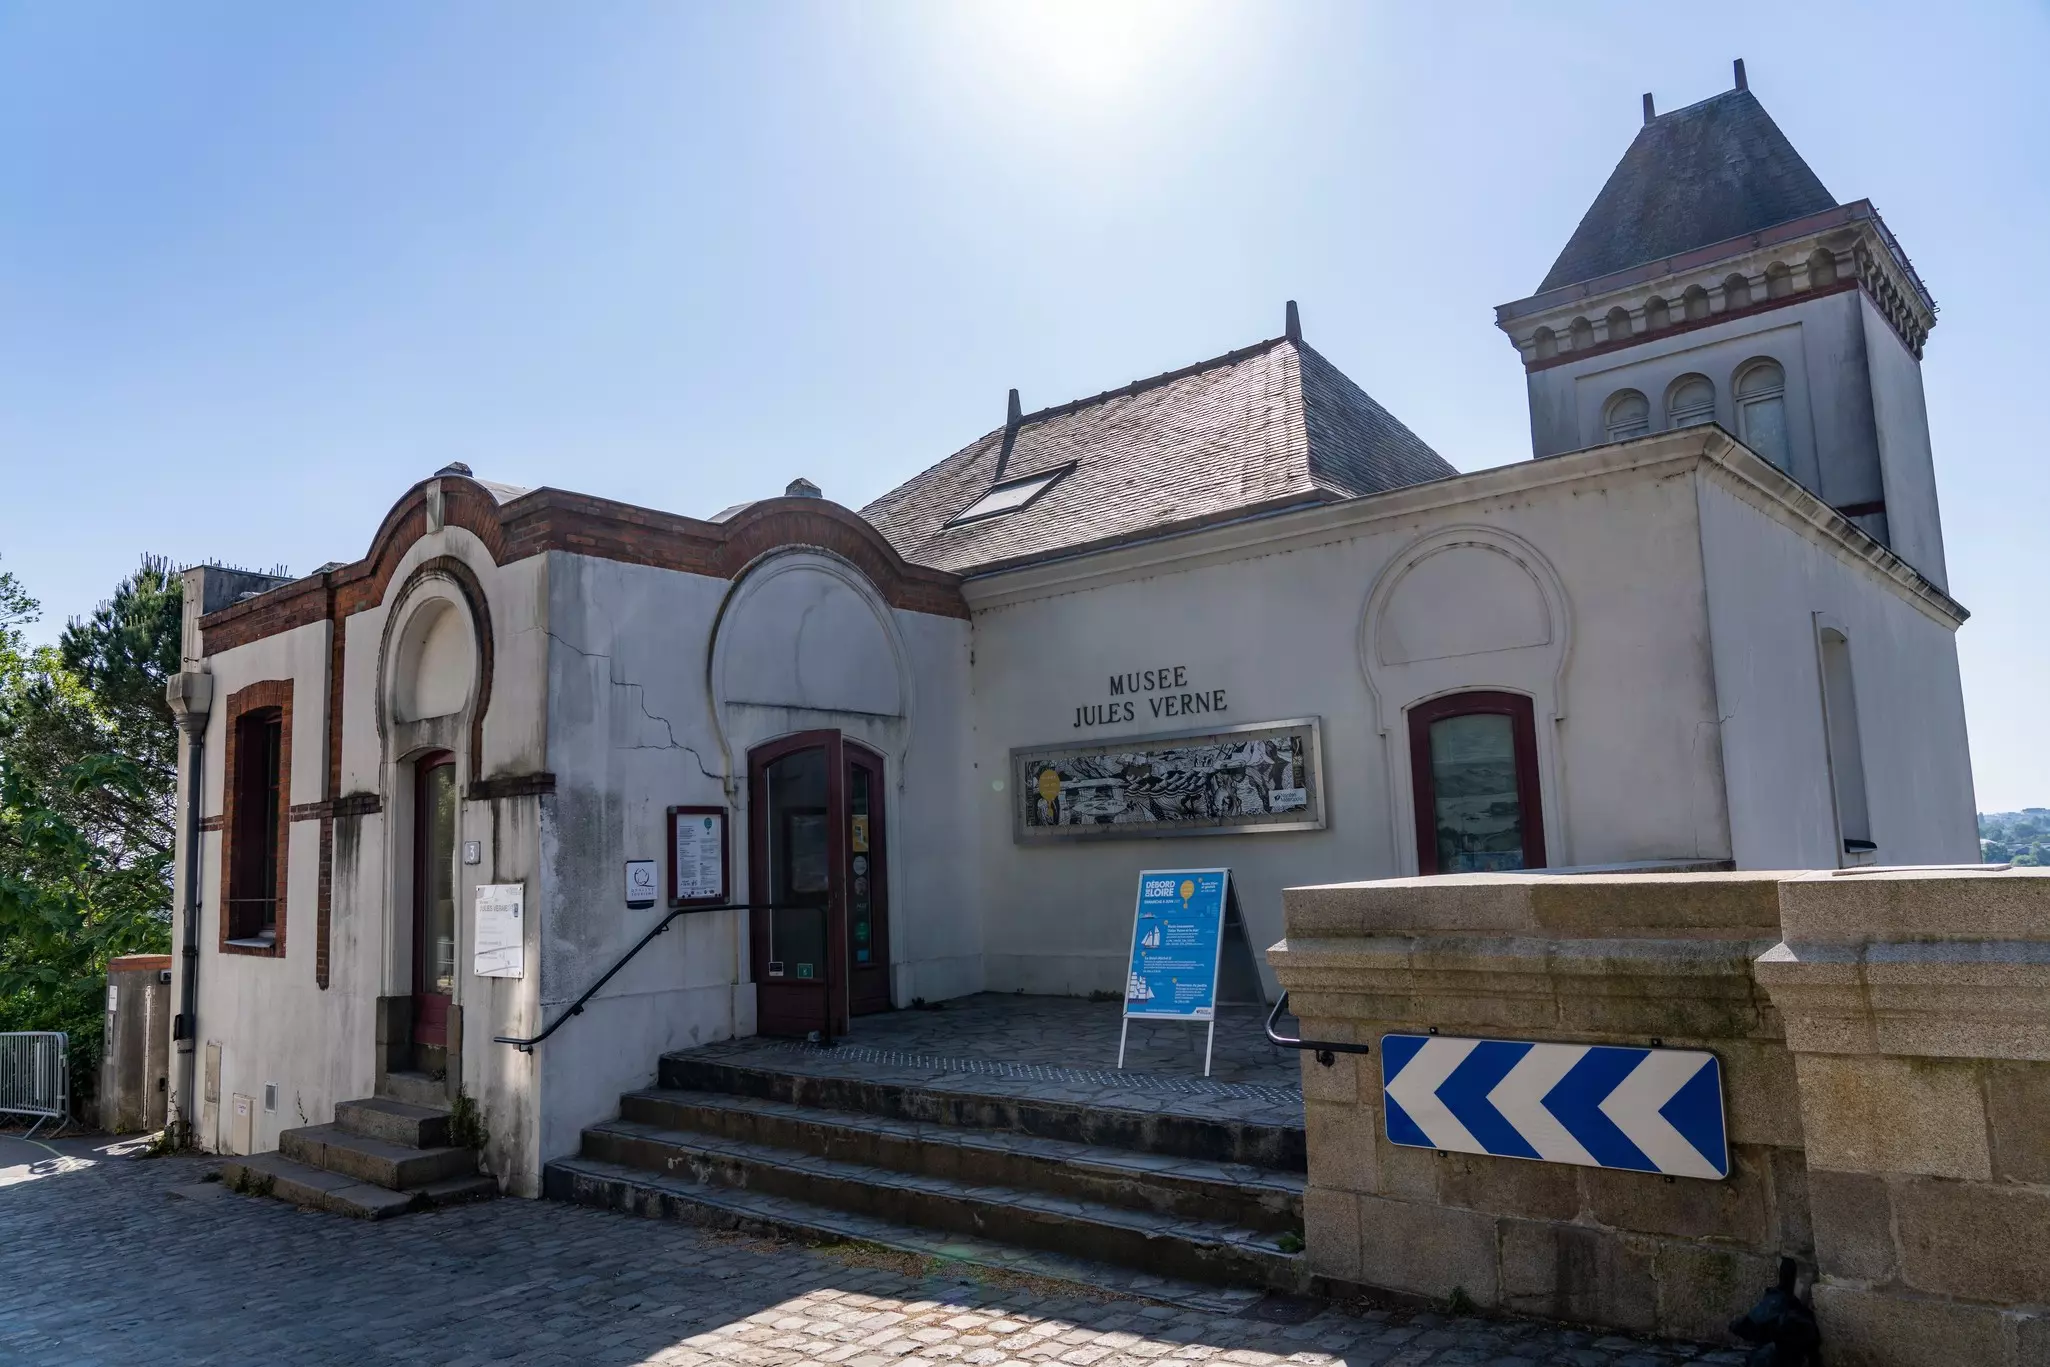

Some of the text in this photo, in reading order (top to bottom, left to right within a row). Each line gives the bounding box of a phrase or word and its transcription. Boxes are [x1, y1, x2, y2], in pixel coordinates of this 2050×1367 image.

[1109, 665, 1188, 697] MUSEE
[1073, 689, 1228, 728] JULES VERNE
[469, 845, 475, 861] 3
[1145, 880, 1176, 889] DÉBORD
[1150, 887, 1175, 897] LOIRE
